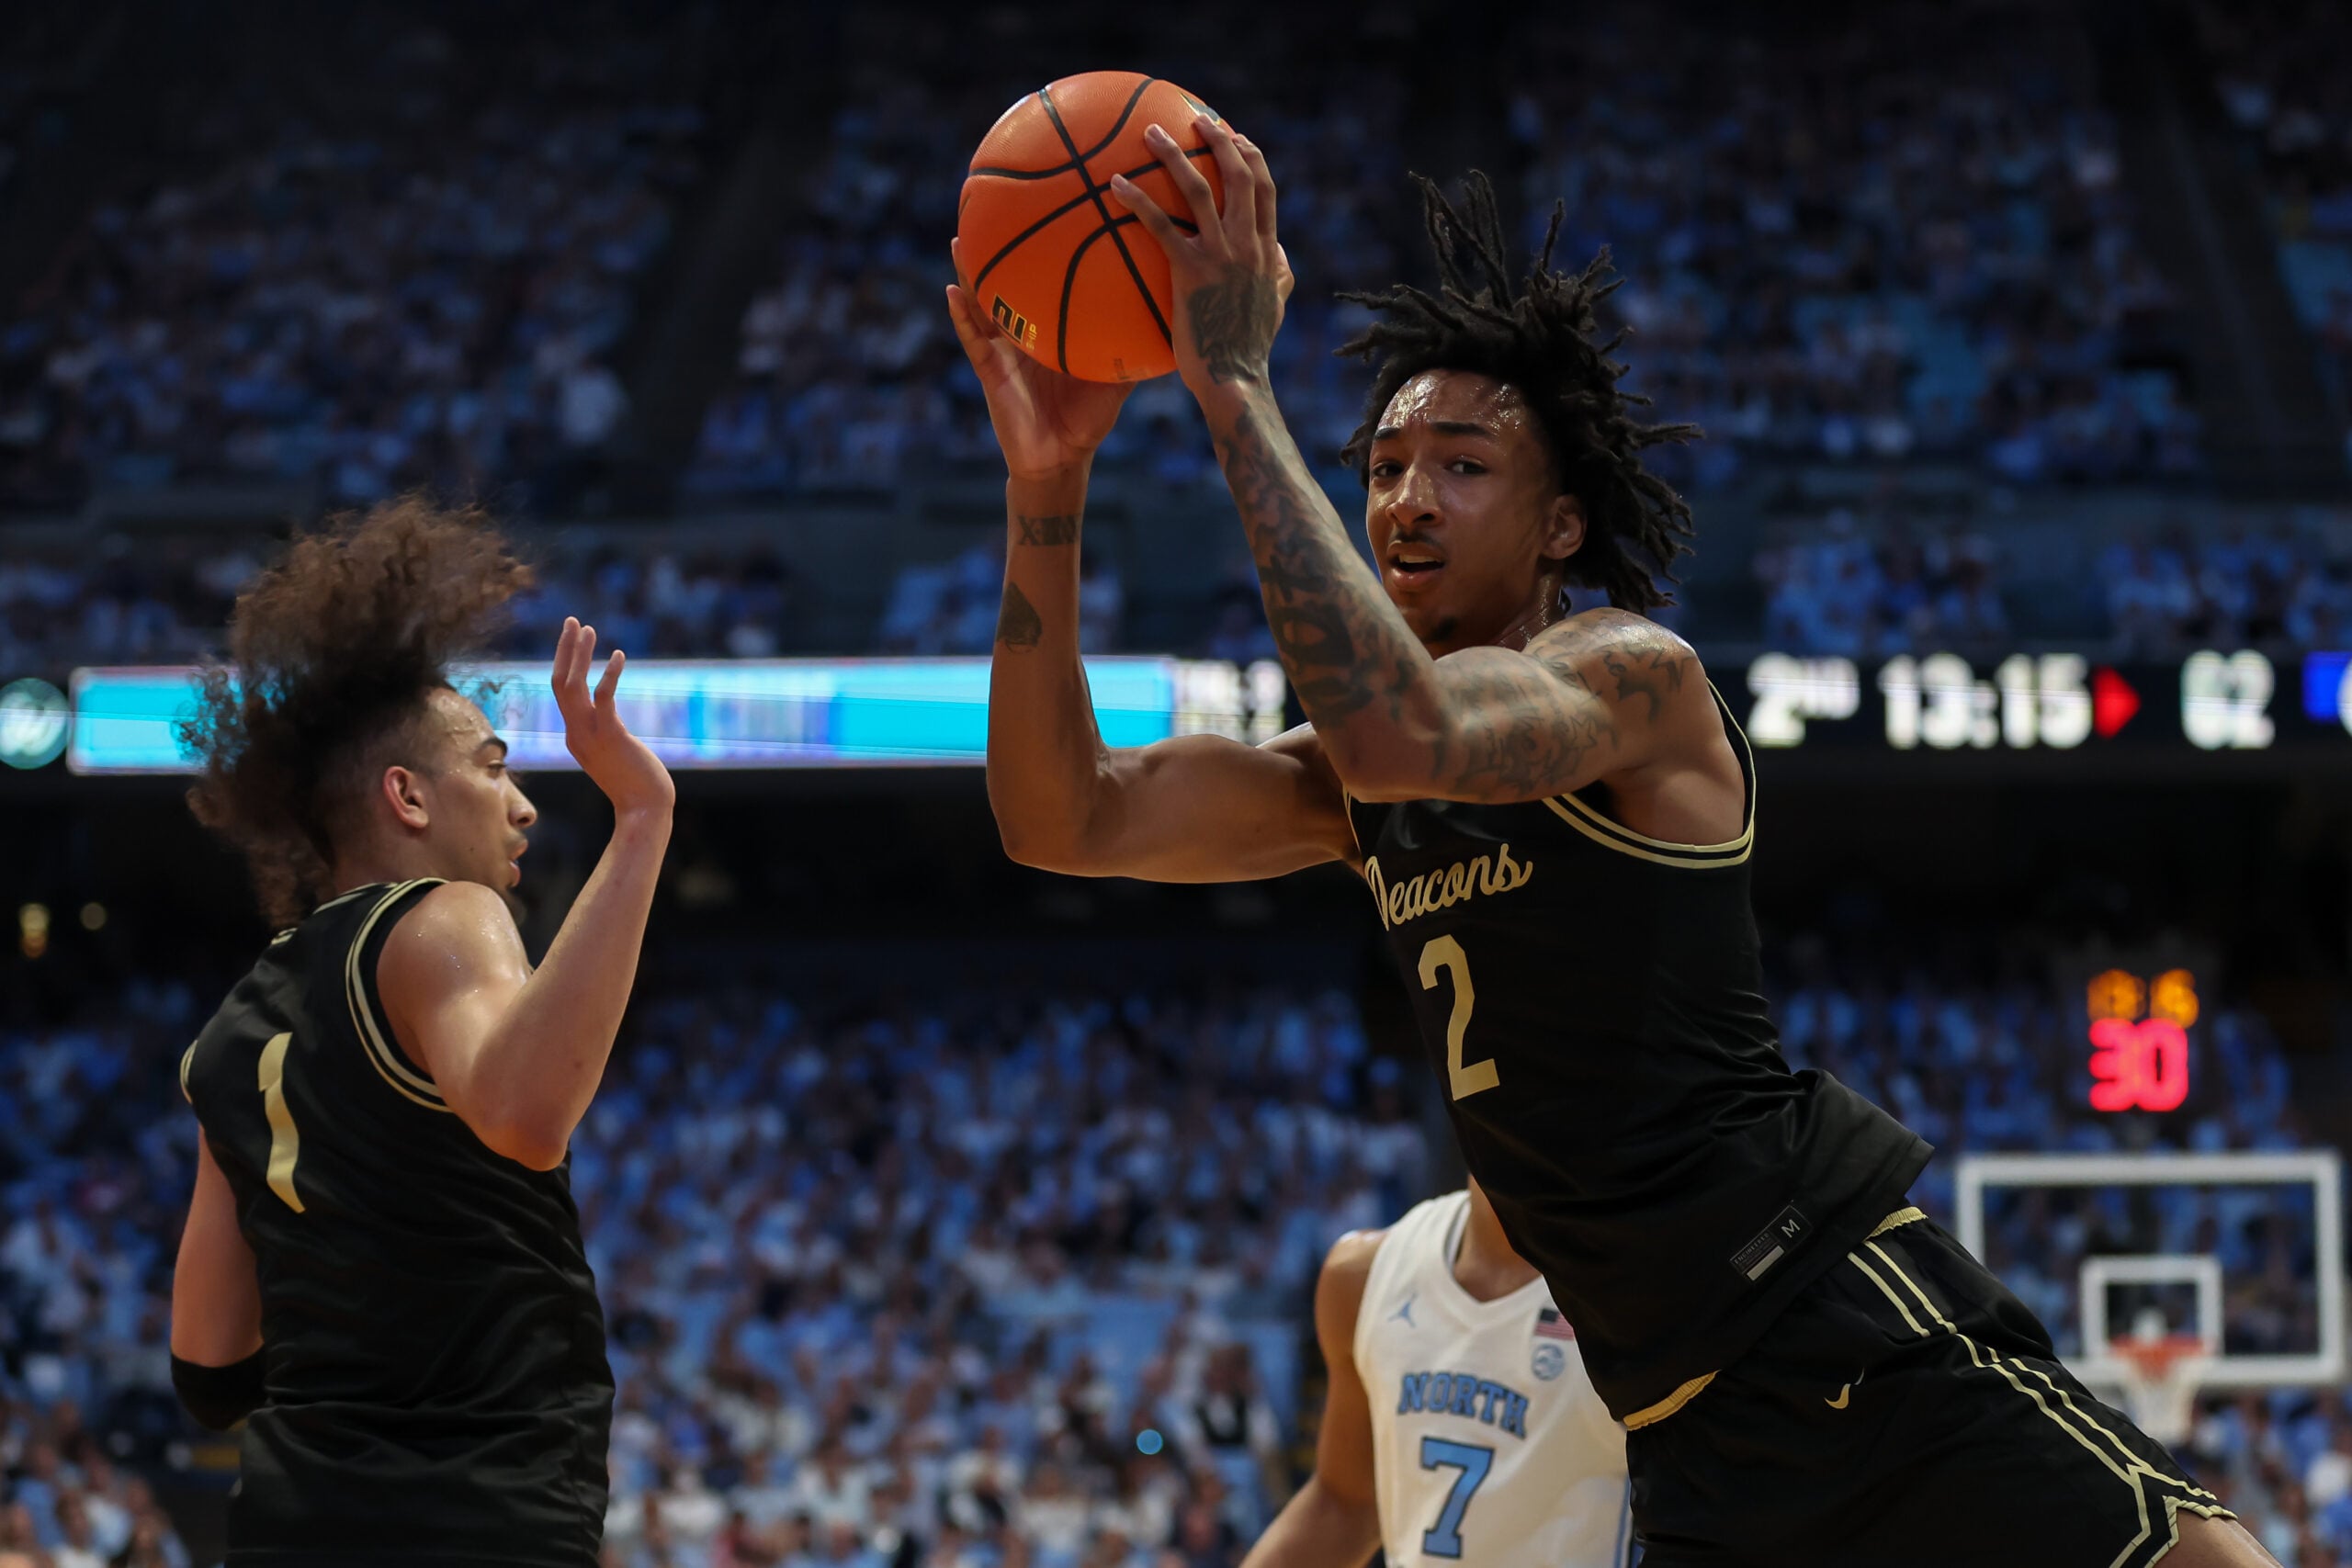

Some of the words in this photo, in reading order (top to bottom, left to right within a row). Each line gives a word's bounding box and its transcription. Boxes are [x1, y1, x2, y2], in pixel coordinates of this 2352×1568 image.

[1880, 653, 2091, 749] 13:15
[2182, 650, 2276, 750] 62
[1418, 933, 1500, 1101] 2
[2088, 1018, 2189, 1111] 30
[258, 1031, 306, 1214] 1
[1781, 1218, 1801, 1238] M
[1397, 1371, 1530, 1439] NORTH
[1420, 1436, 1495, 1559] 7
